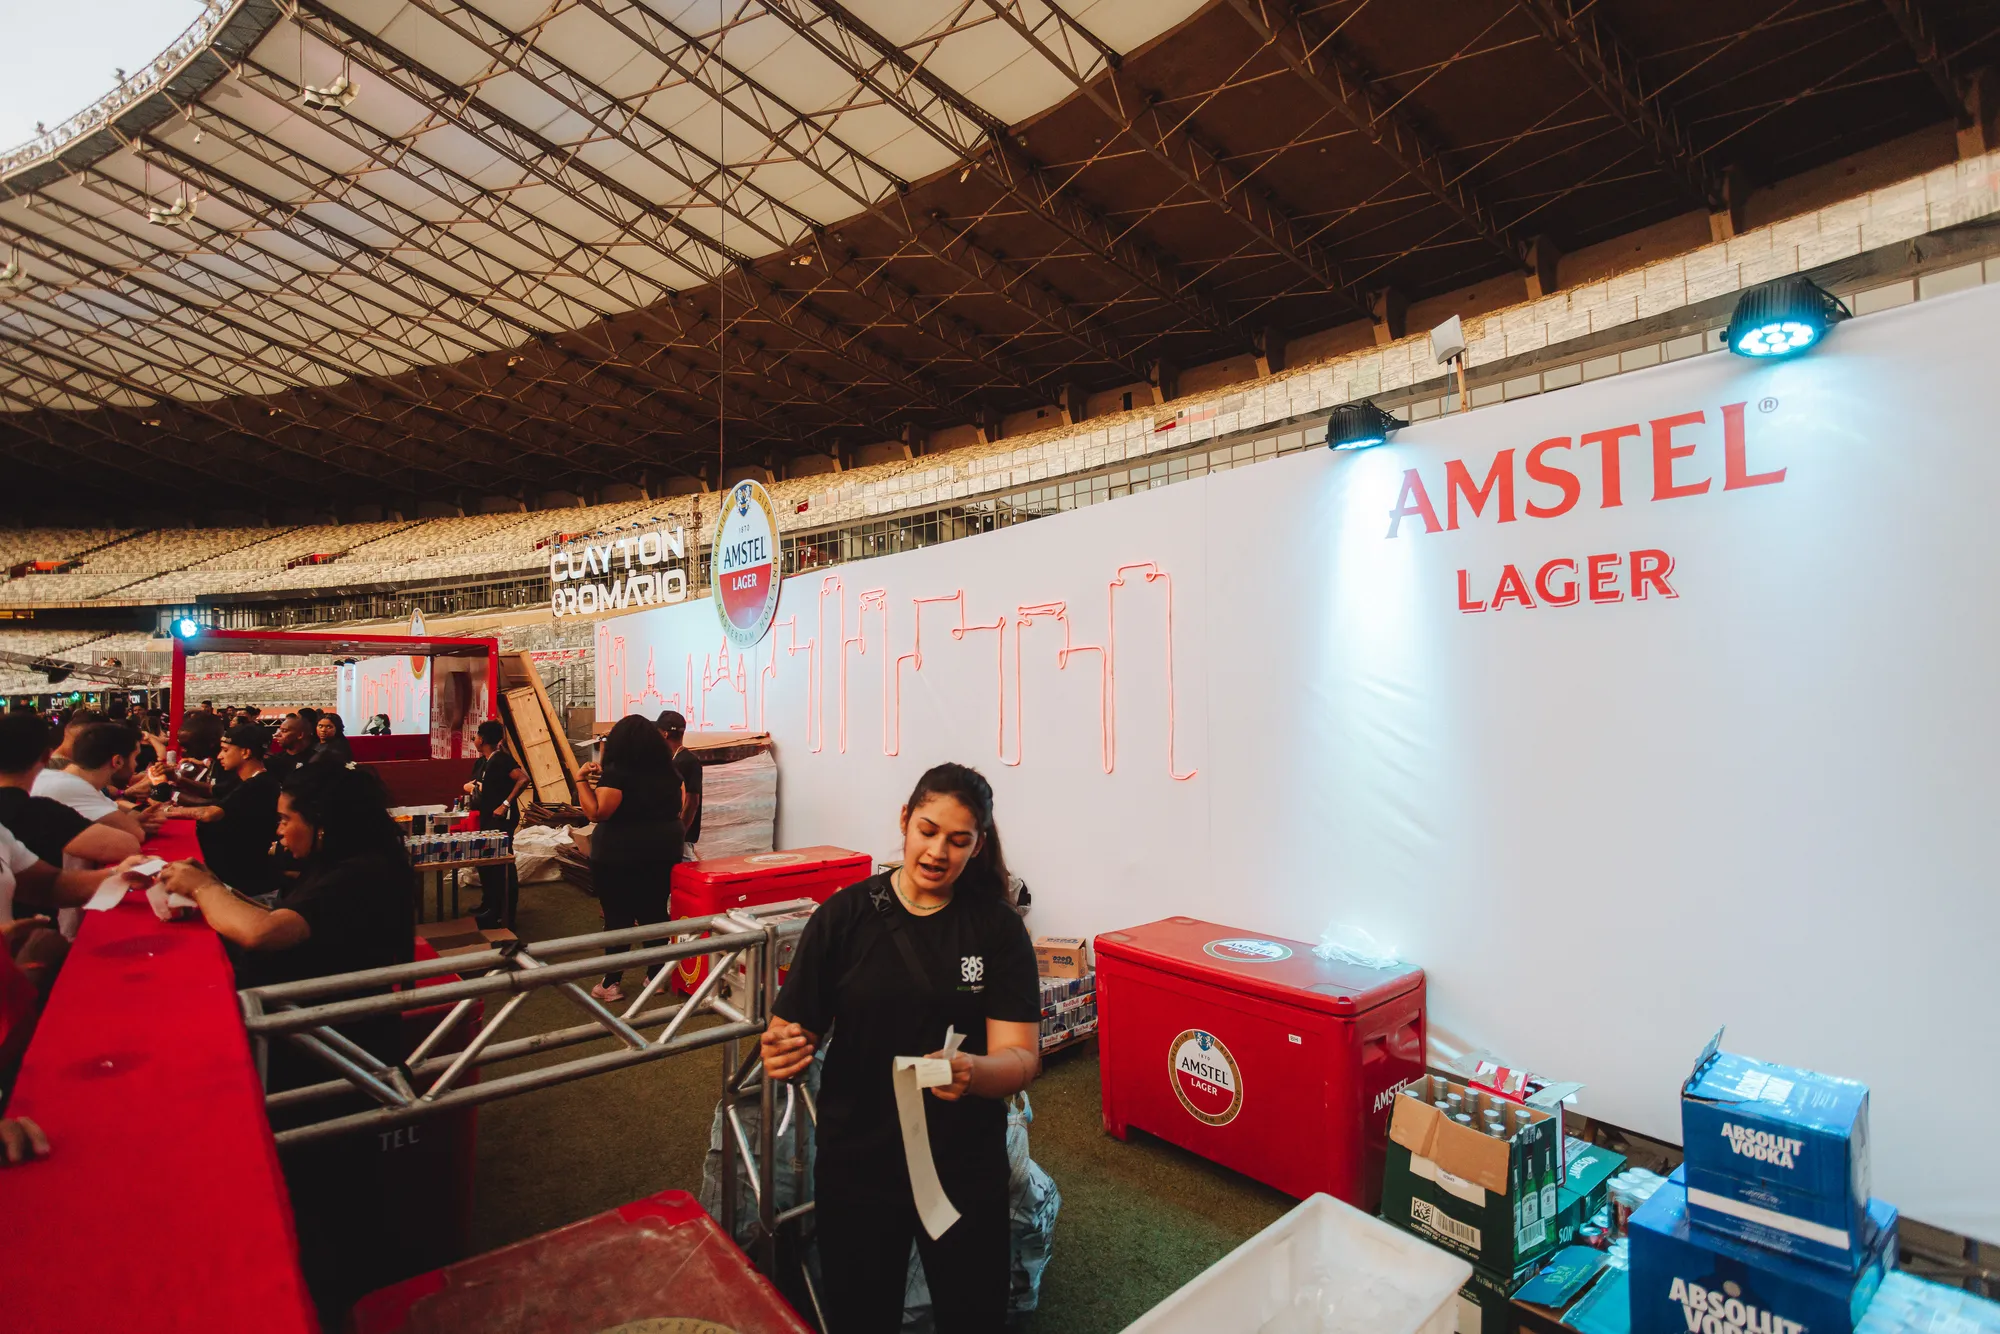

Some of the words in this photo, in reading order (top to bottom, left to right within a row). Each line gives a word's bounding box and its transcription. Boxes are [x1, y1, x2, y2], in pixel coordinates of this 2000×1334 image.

[550, 525, 685, 582] CLAYTON
[723, 535, 767, 570] AMSTEL
[732, 572, 758, 591] LAGER
[1456, 549, 1680, 614] LAGER
[1181, 1056, 1229, 1086] AMSTEL
[1190, 1077, 1218, 1096] LAGER
[1720, 1122, 1803, 1157] ABSOLUT
[1729, 1137, 1795, 1170] VODKA
[1668, 1277, 1804, 1334] ABSOLUT
